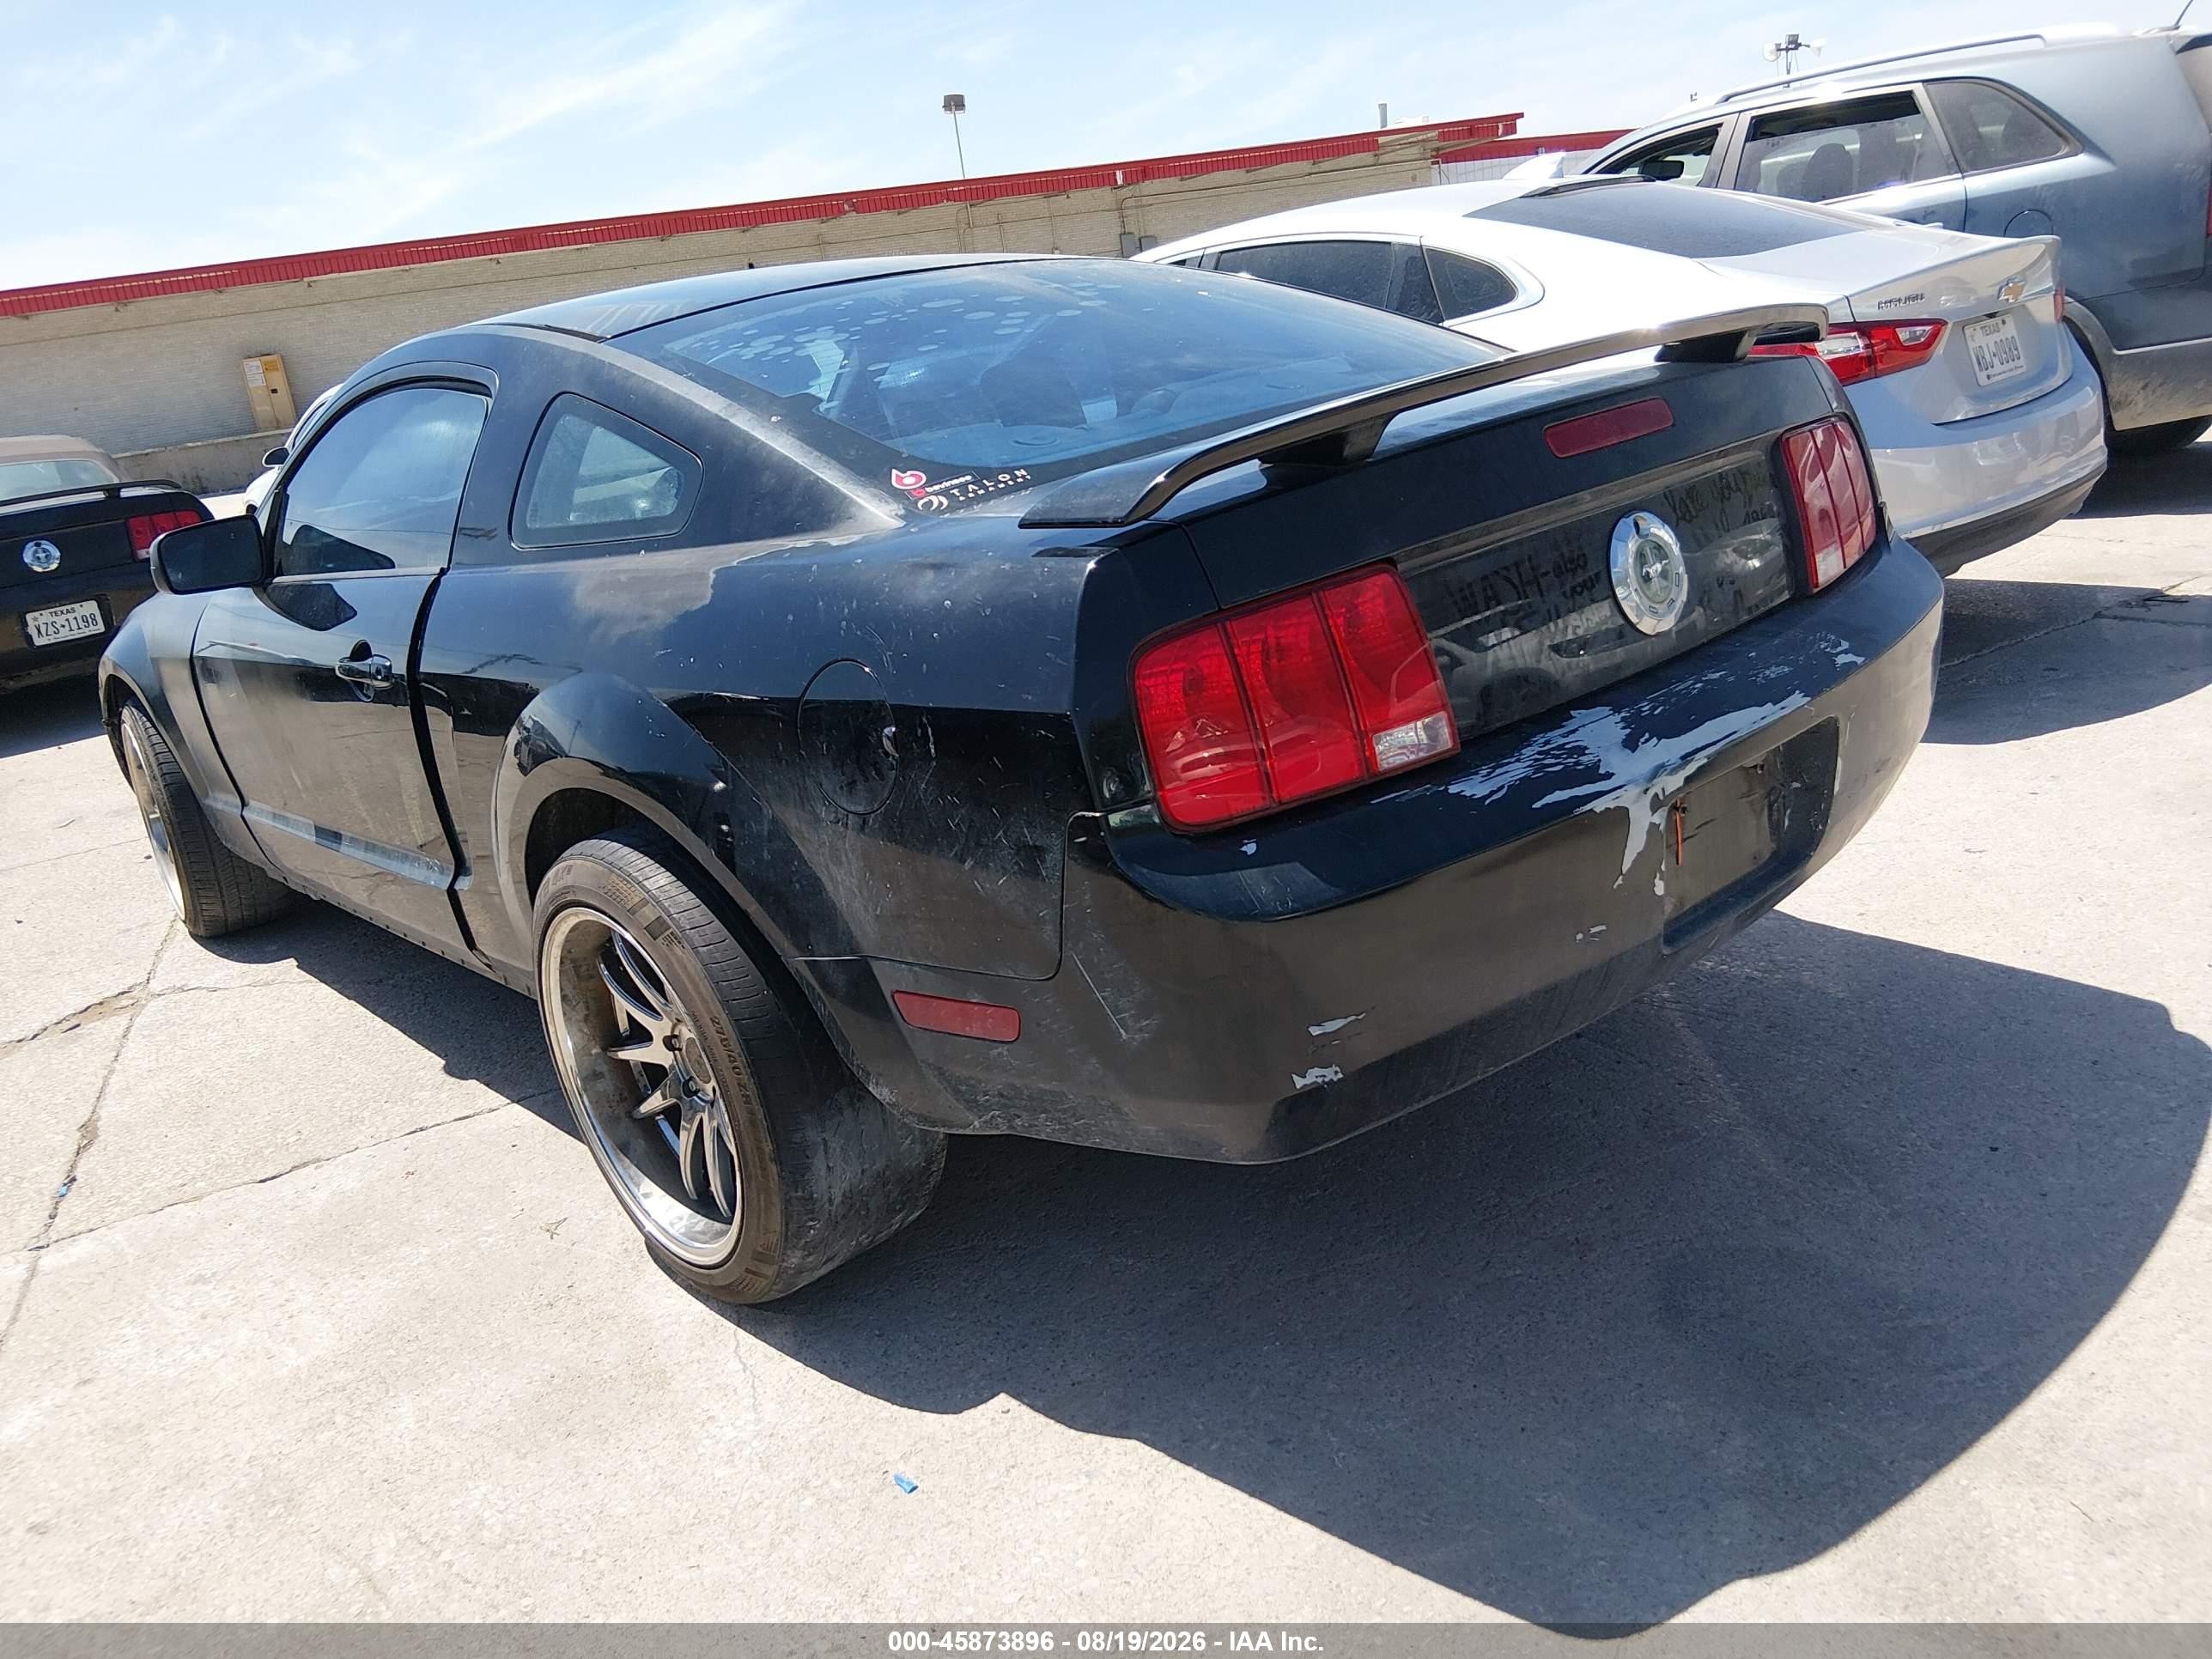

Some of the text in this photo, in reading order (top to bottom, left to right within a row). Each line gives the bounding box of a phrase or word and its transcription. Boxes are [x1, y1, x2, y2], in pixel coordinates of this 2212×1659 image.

[1980, 322, 2001, 337] TEXAS
[950, 468, 1028, 496] TALON
[48, 607, 76, 617] TEXAS
